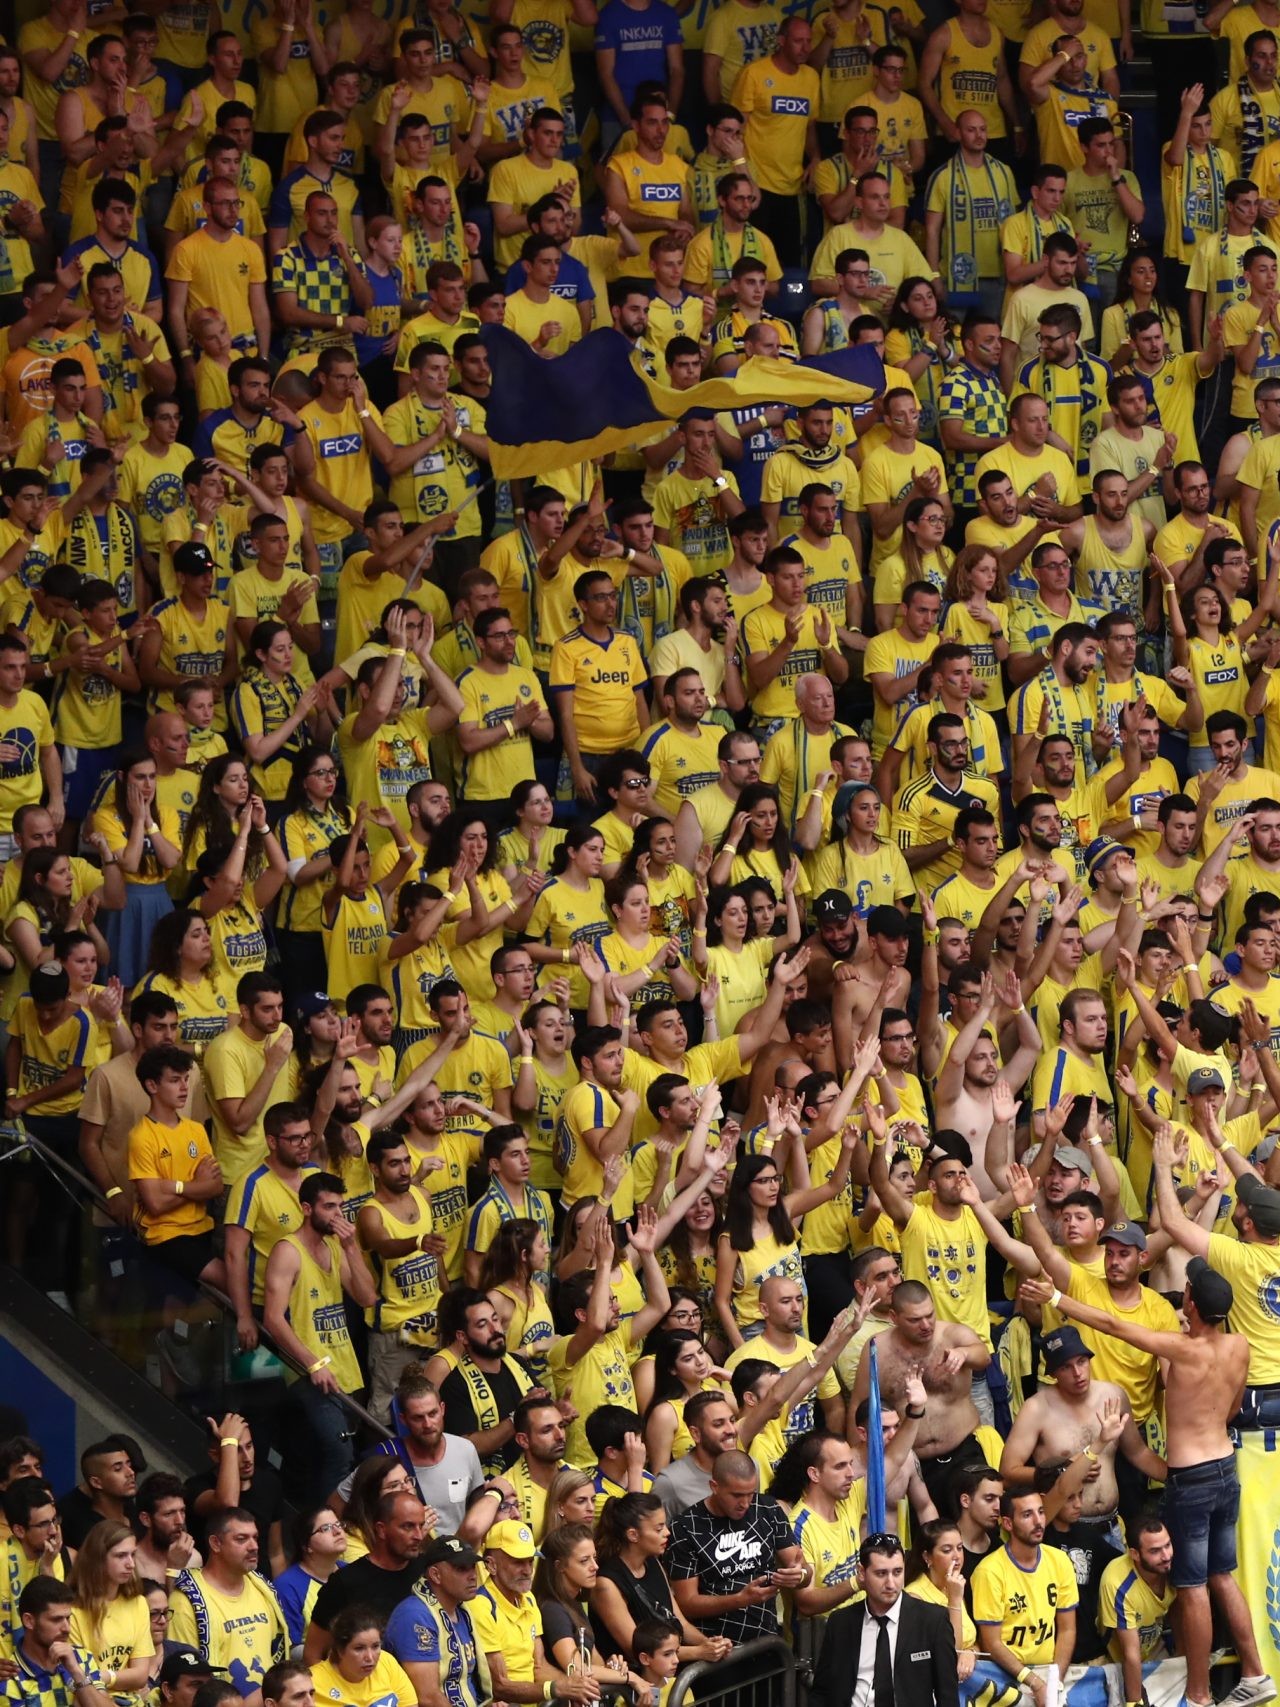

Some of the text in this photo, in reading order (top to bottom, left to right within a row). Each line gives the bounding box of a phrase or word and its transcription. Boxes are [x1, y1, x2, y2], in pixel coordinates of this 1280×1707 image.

[775, 100, 807, 112] FOX
[645, 187, 679, 199] FOX
[591, 670, 629, 685] Jeep
[1207, 671, 1236, 684] FOX
[348, 941, 366, 955] TEL
[720, 1530, 746, 1551] NIKE
[739, 1541, 763, 1561] AIR
[1046, 1583, 1057, 1607] 6
[222, 1612, 269, 1635] ULTRAS
